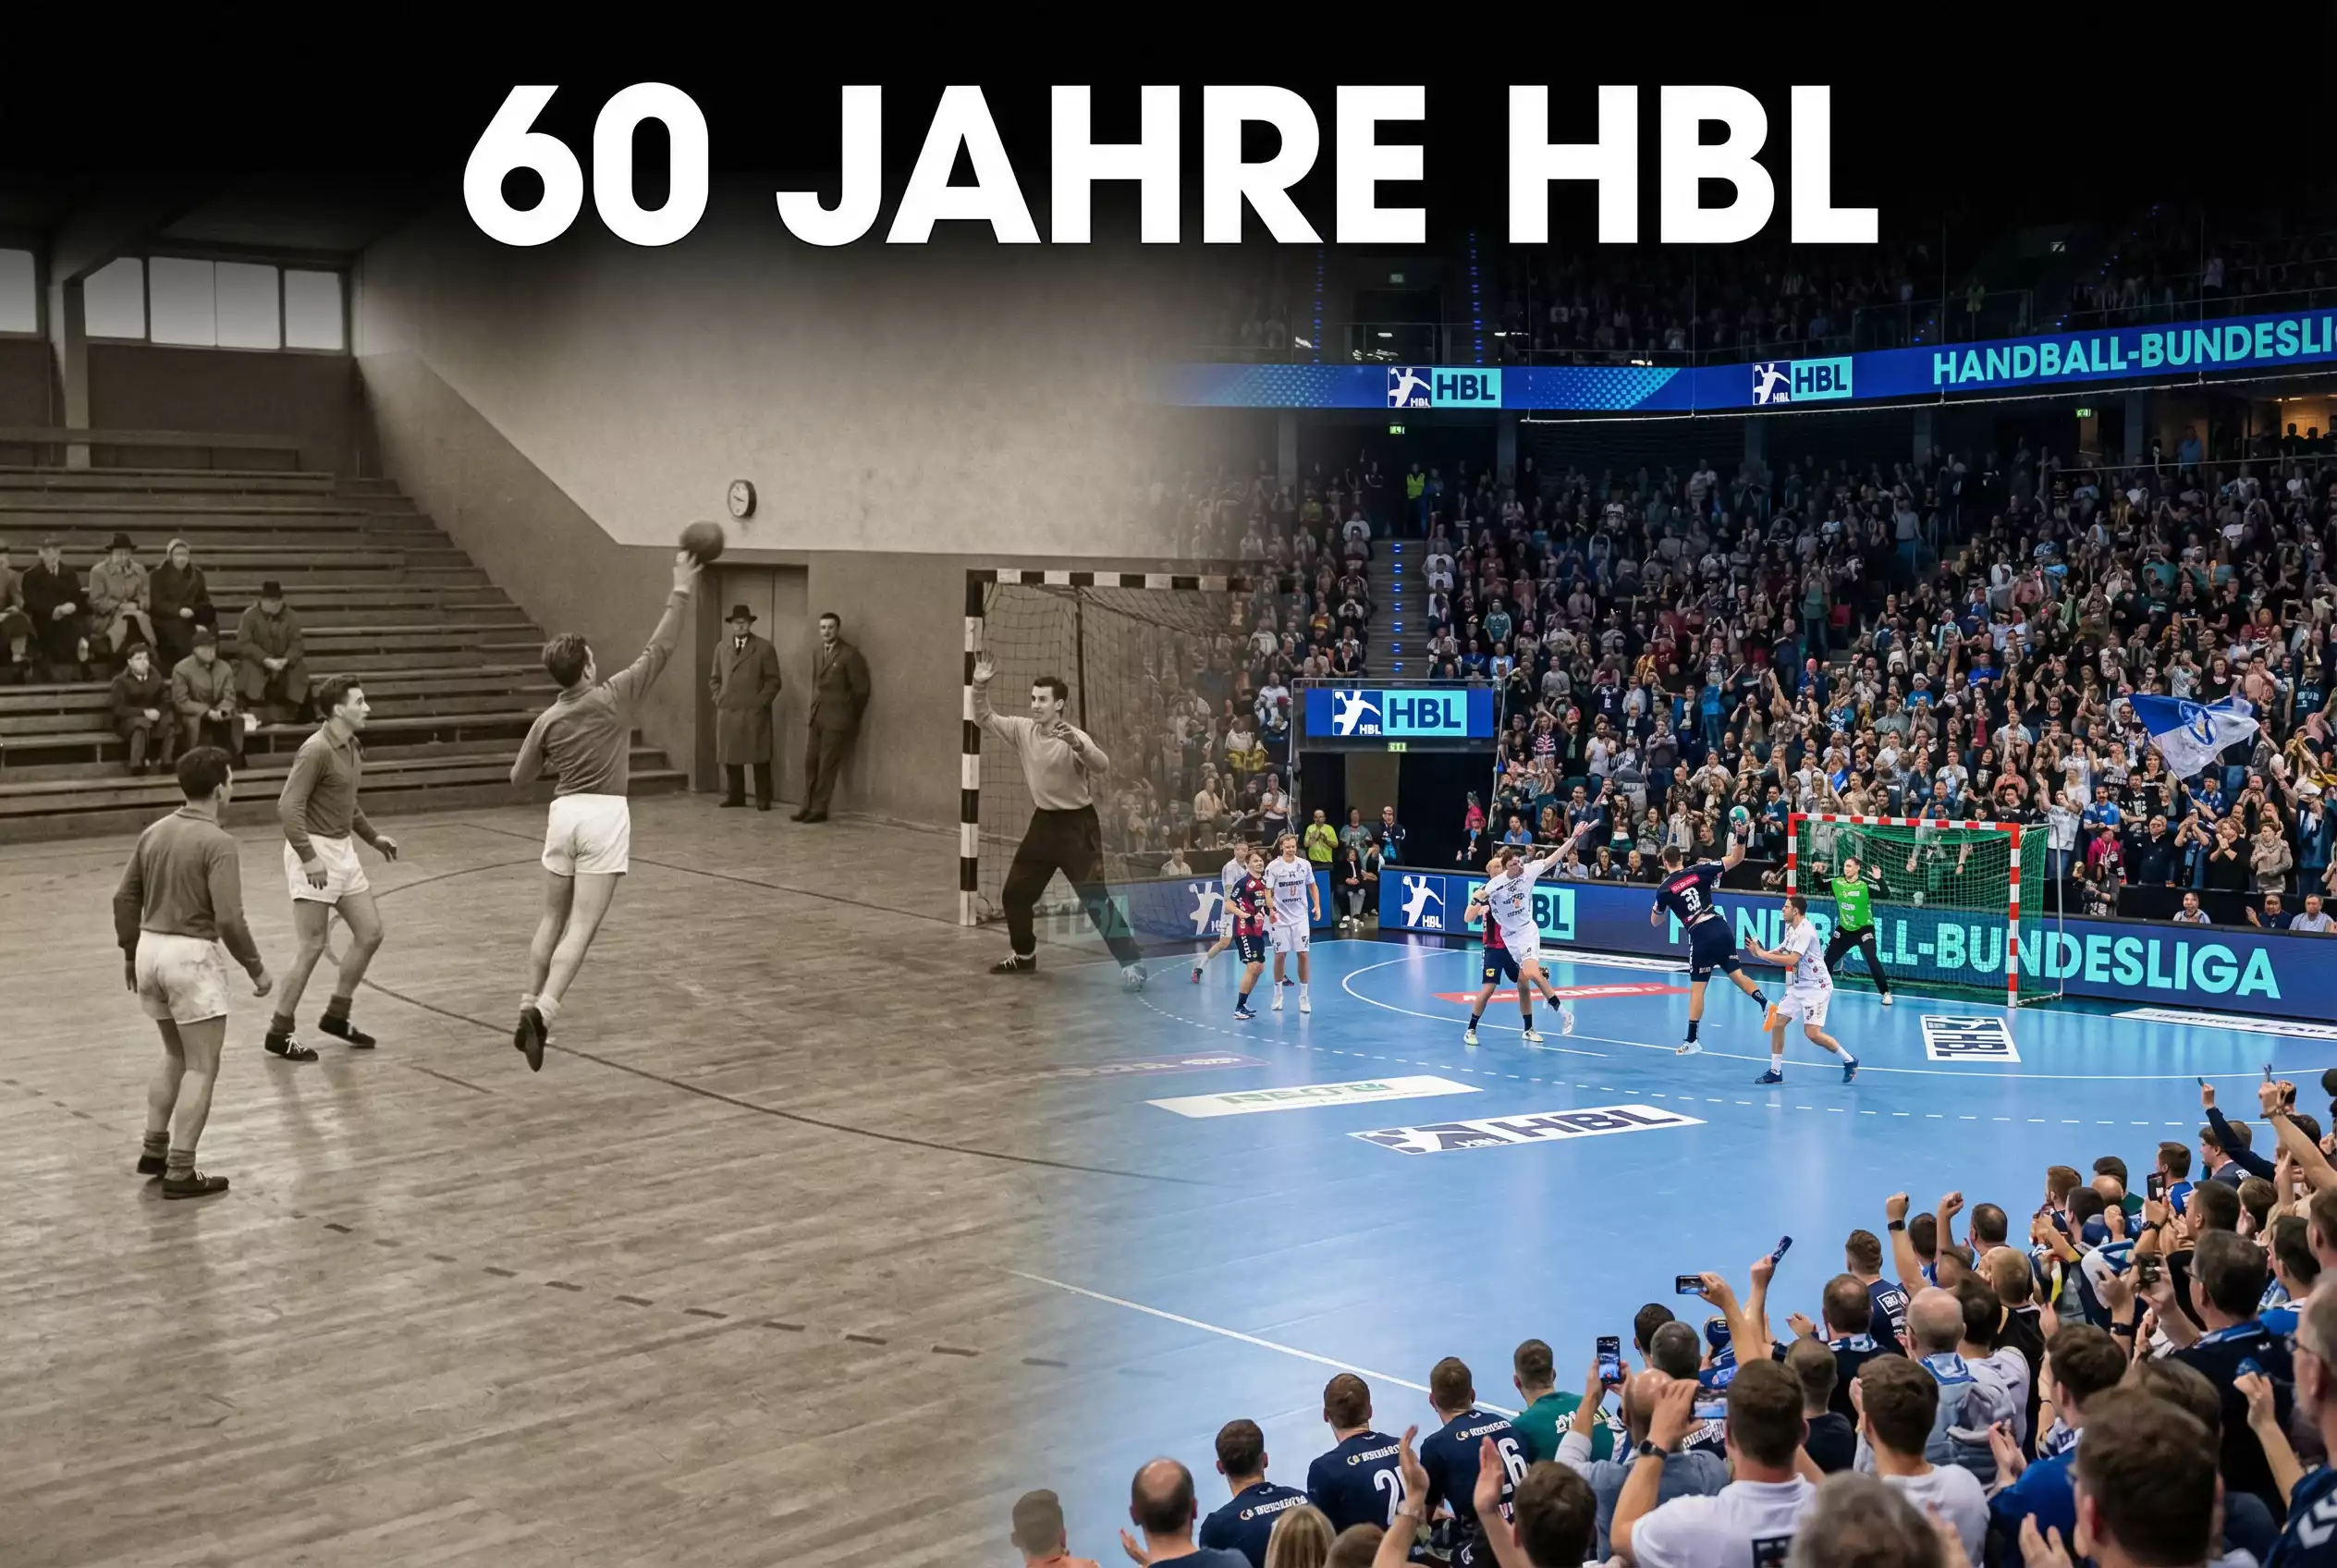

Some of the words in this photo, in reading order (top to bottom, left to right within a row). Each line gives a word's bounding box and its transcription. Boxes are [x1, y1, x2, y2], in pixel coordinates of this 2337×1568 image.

[1933, 316, 2337, 385] HANDBALL-BUNDESLI
[1437, 374, 1496, 400] HBL
[1794, 363, 1847, 394] HBL
[1389, 698, 1461, 729] HBL
[1359, 724, 1381, 735] HBL
[1423, 914, 1442, 928] HBL
[1669, 905, 2282, 999] NBLL-BUNDESLIGA
[1487, 1109, 1683, 1138] HBL
